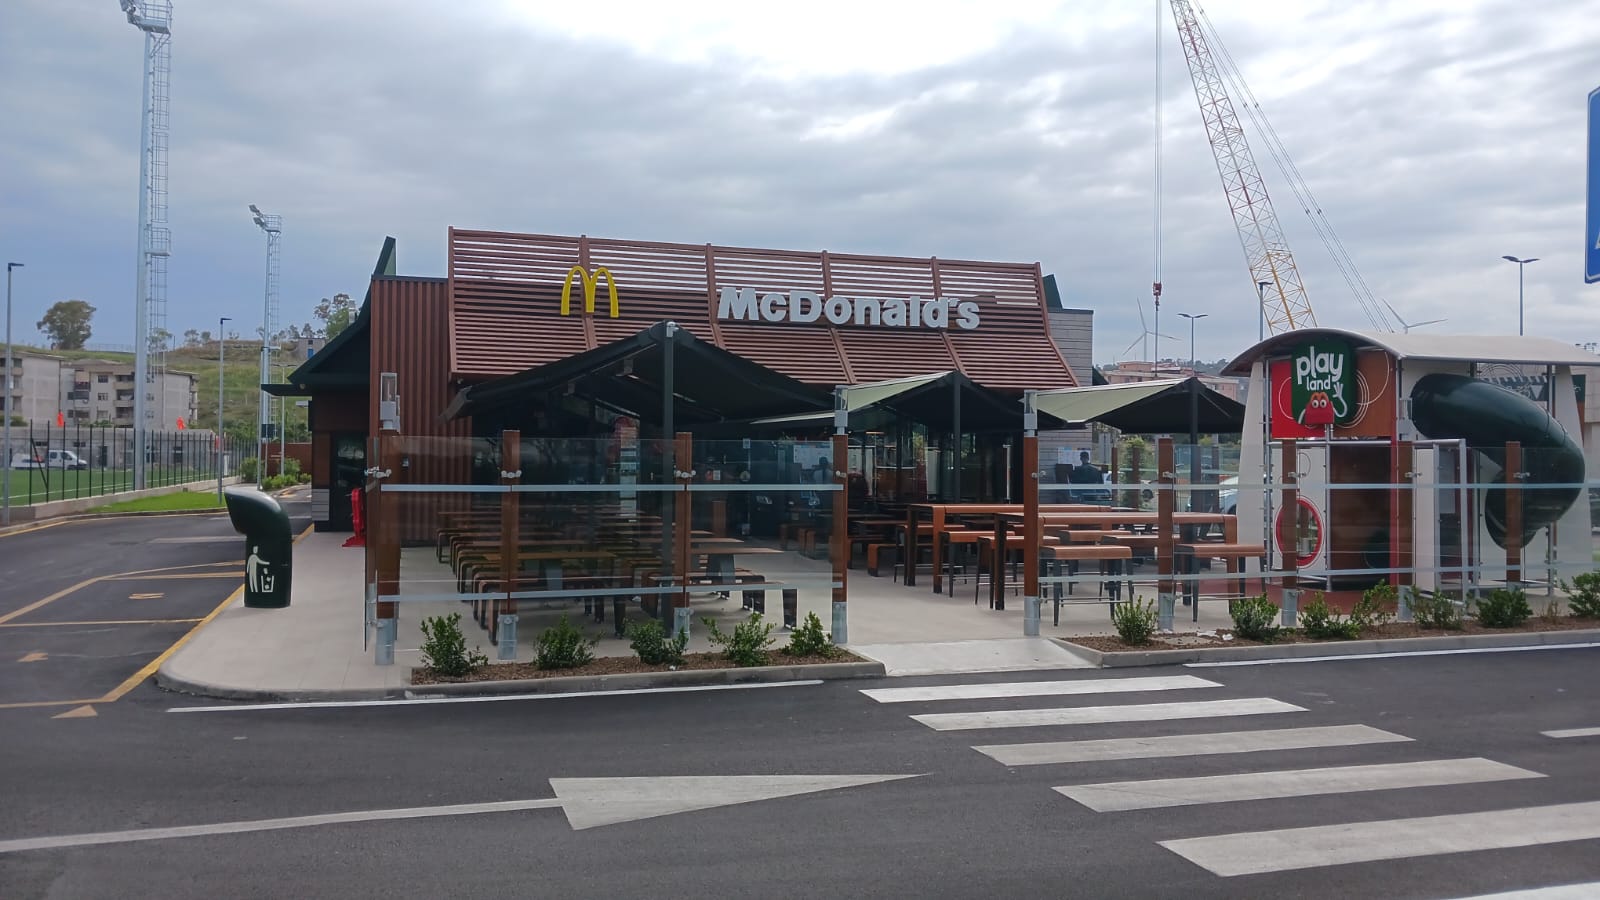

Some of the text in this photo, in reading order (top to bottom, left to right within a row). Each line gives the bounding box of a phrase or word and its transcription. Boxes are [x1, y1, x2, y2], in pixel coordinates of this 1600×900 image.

[717, 286, 980, 330] McDonald's
[1296, 346, 1344, 384] play
[1306, 375, 1331, 391] land
